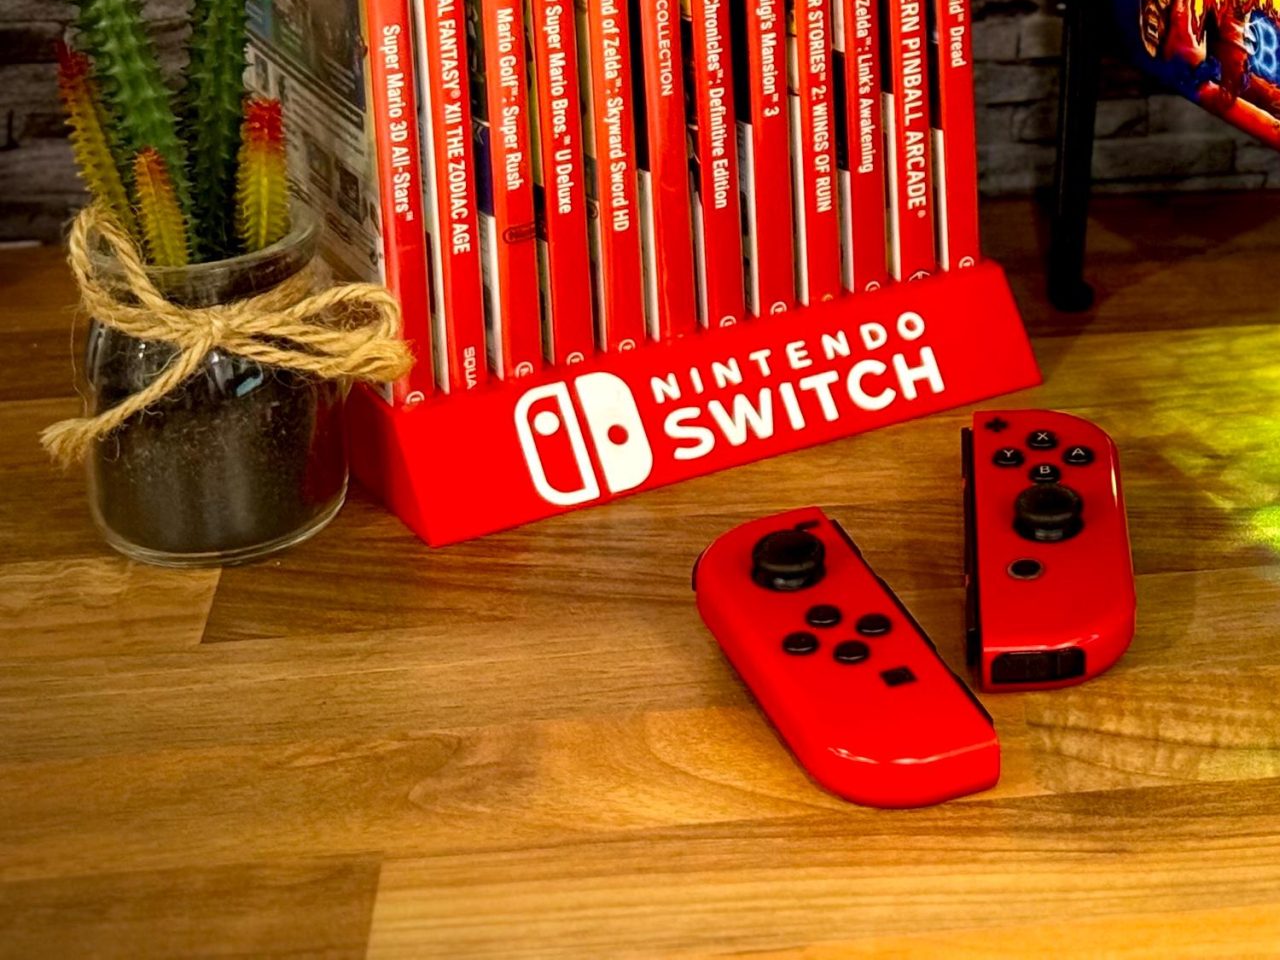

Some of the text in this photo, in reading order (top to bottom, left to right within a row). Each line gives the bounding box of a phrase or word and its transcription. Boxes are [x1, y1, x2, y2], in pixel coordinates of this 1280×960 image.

[377, 24, 401, 70] Super
[495, 7, 516, 50] Mario
[543, 4, 563, 49] Super
[601, 18, 620, 37] of
[950, 25, 967, 67] Dread
[655, 0, 673, 96] COLLECTION
[548, 52, 567, 95] Mario
[811, 85, 827, 101] 2:
[857, 53, 874, 95] Link's
[902, 37, 923, 126] PINBALL
[385, 72, 406, 119] Mario
[443, 101, 462, 125] XII
[763, 106, 780, 117] 3
[388, 120, 408, 143] 3D
[446, 125, 465, 159] THE
[499, 105, 520, 149] Super
[603, 96, 627, 160] Skyward
[708, 87, 729, 157] Definitive
[812, 102, 830, 152] WINGS
[858, 98, 876, 174] Awakening
[505, 151, 524, 191] Rush
[554, 148, 572, 161] U
[814, 154, 831, 174] OF
[447, 159, 469, 220] ZODIAC
[555, 163, 575, 214] Deluxe
[610, 161, 629, 208] Sword
[712, 158, 730, 209] Edition
[815, 175, 832, 213] RUIN
[452, 223, 471, 255] AGE
[613, 209, 630, 232] HD
[650, 311, 926, 404] NINTENDO
[663, 346, 945, 461] SWITCH
[1002, 449, 1015, 459] Y
[1036, 431, 1049, 442] X
[1071, 447, 1086, 457] A
[1039, 465, 1052, 475] B
